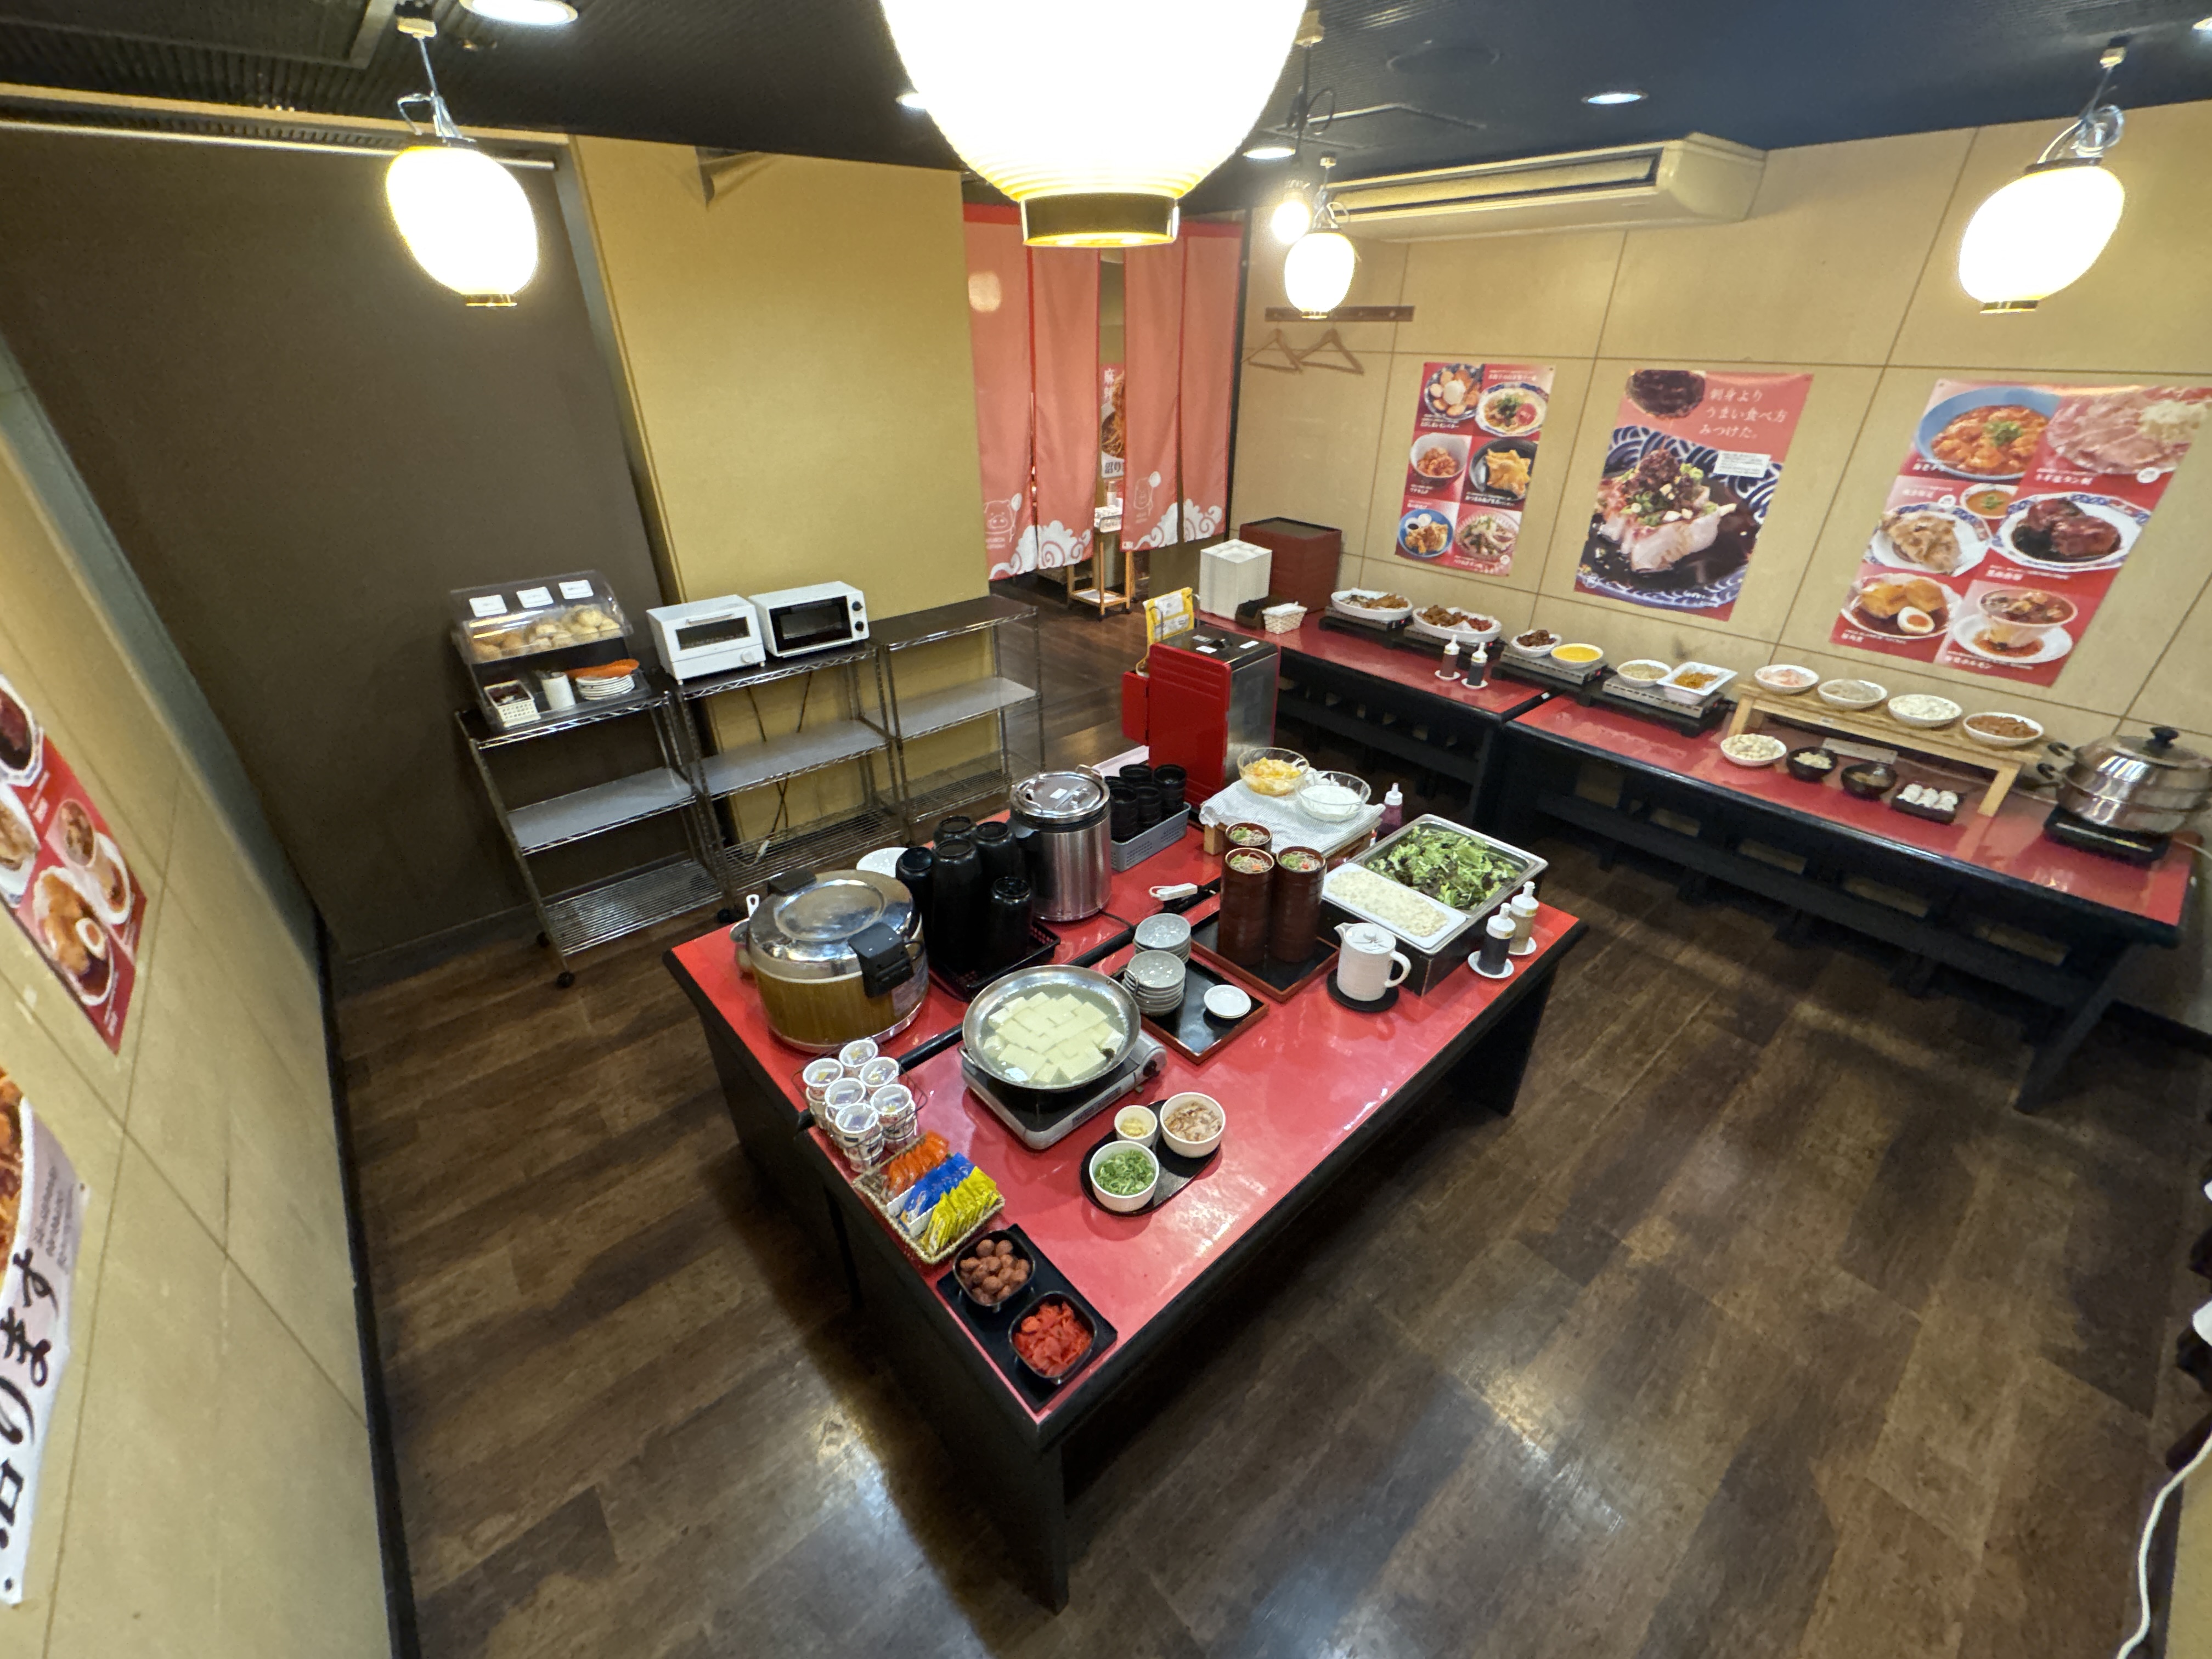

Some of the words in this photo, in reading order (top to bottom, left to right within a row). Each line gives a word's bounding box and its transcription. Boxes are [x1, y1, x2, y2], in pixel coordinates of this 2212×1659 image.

[1709, 388, 1763, 402] 刺身より
[1706, 407, 1788, 423] うまい食べ方
[1699, 424, 1758, 439] みつけた。
[1104, 461, 1124, 474] 沼り
